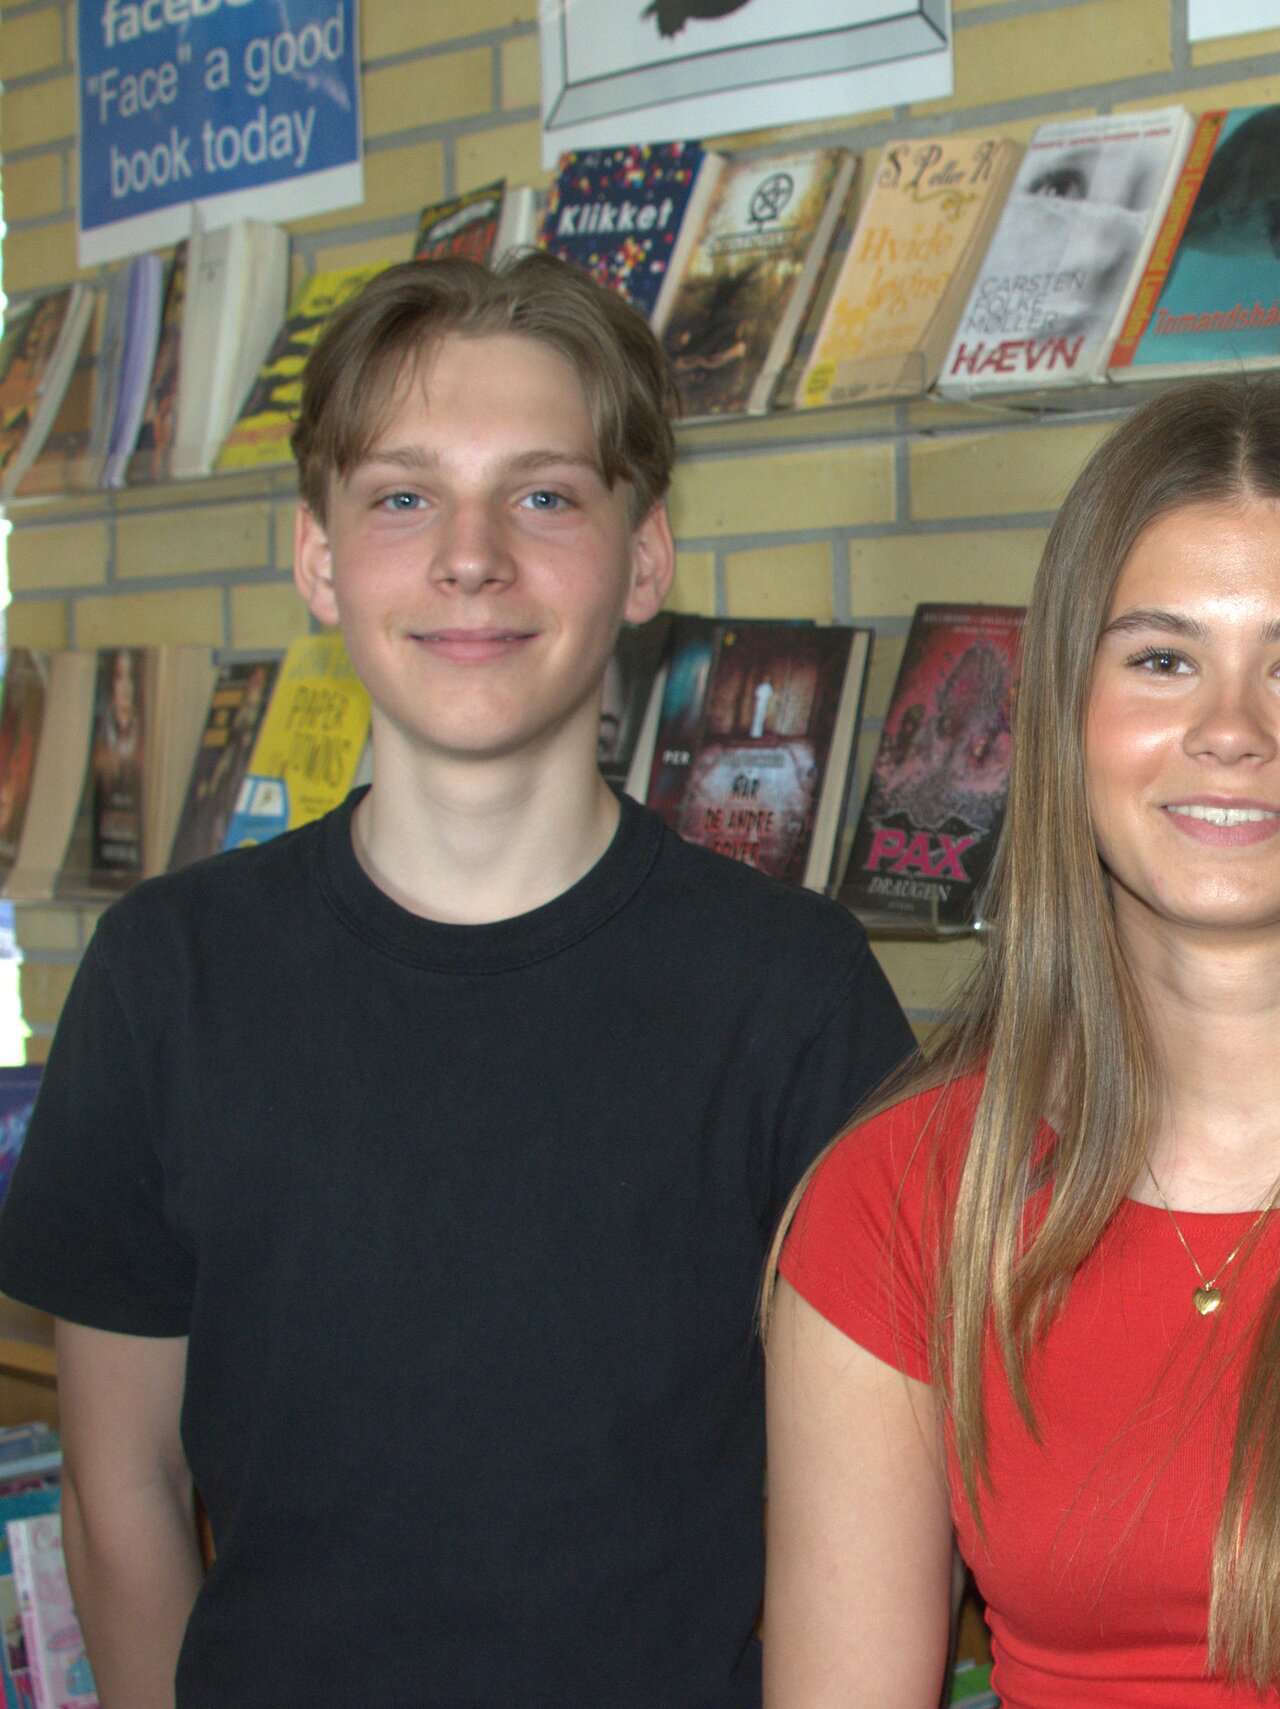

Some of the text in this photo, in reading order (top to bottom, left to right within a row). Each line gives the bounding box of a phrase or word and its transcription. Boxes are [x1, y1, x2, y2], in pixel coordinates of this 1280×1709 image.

[203, 46, 231, 91] a
[243, 0, 345, 96] good
[110, 104, 316, 199] book today
[557, 198, 673, 237] Klikket
[981, 270, 1088, 297] CARSTEN
[951, 335, 1087, 377] HÆVN
[864, 827, 977, 883] PAX
